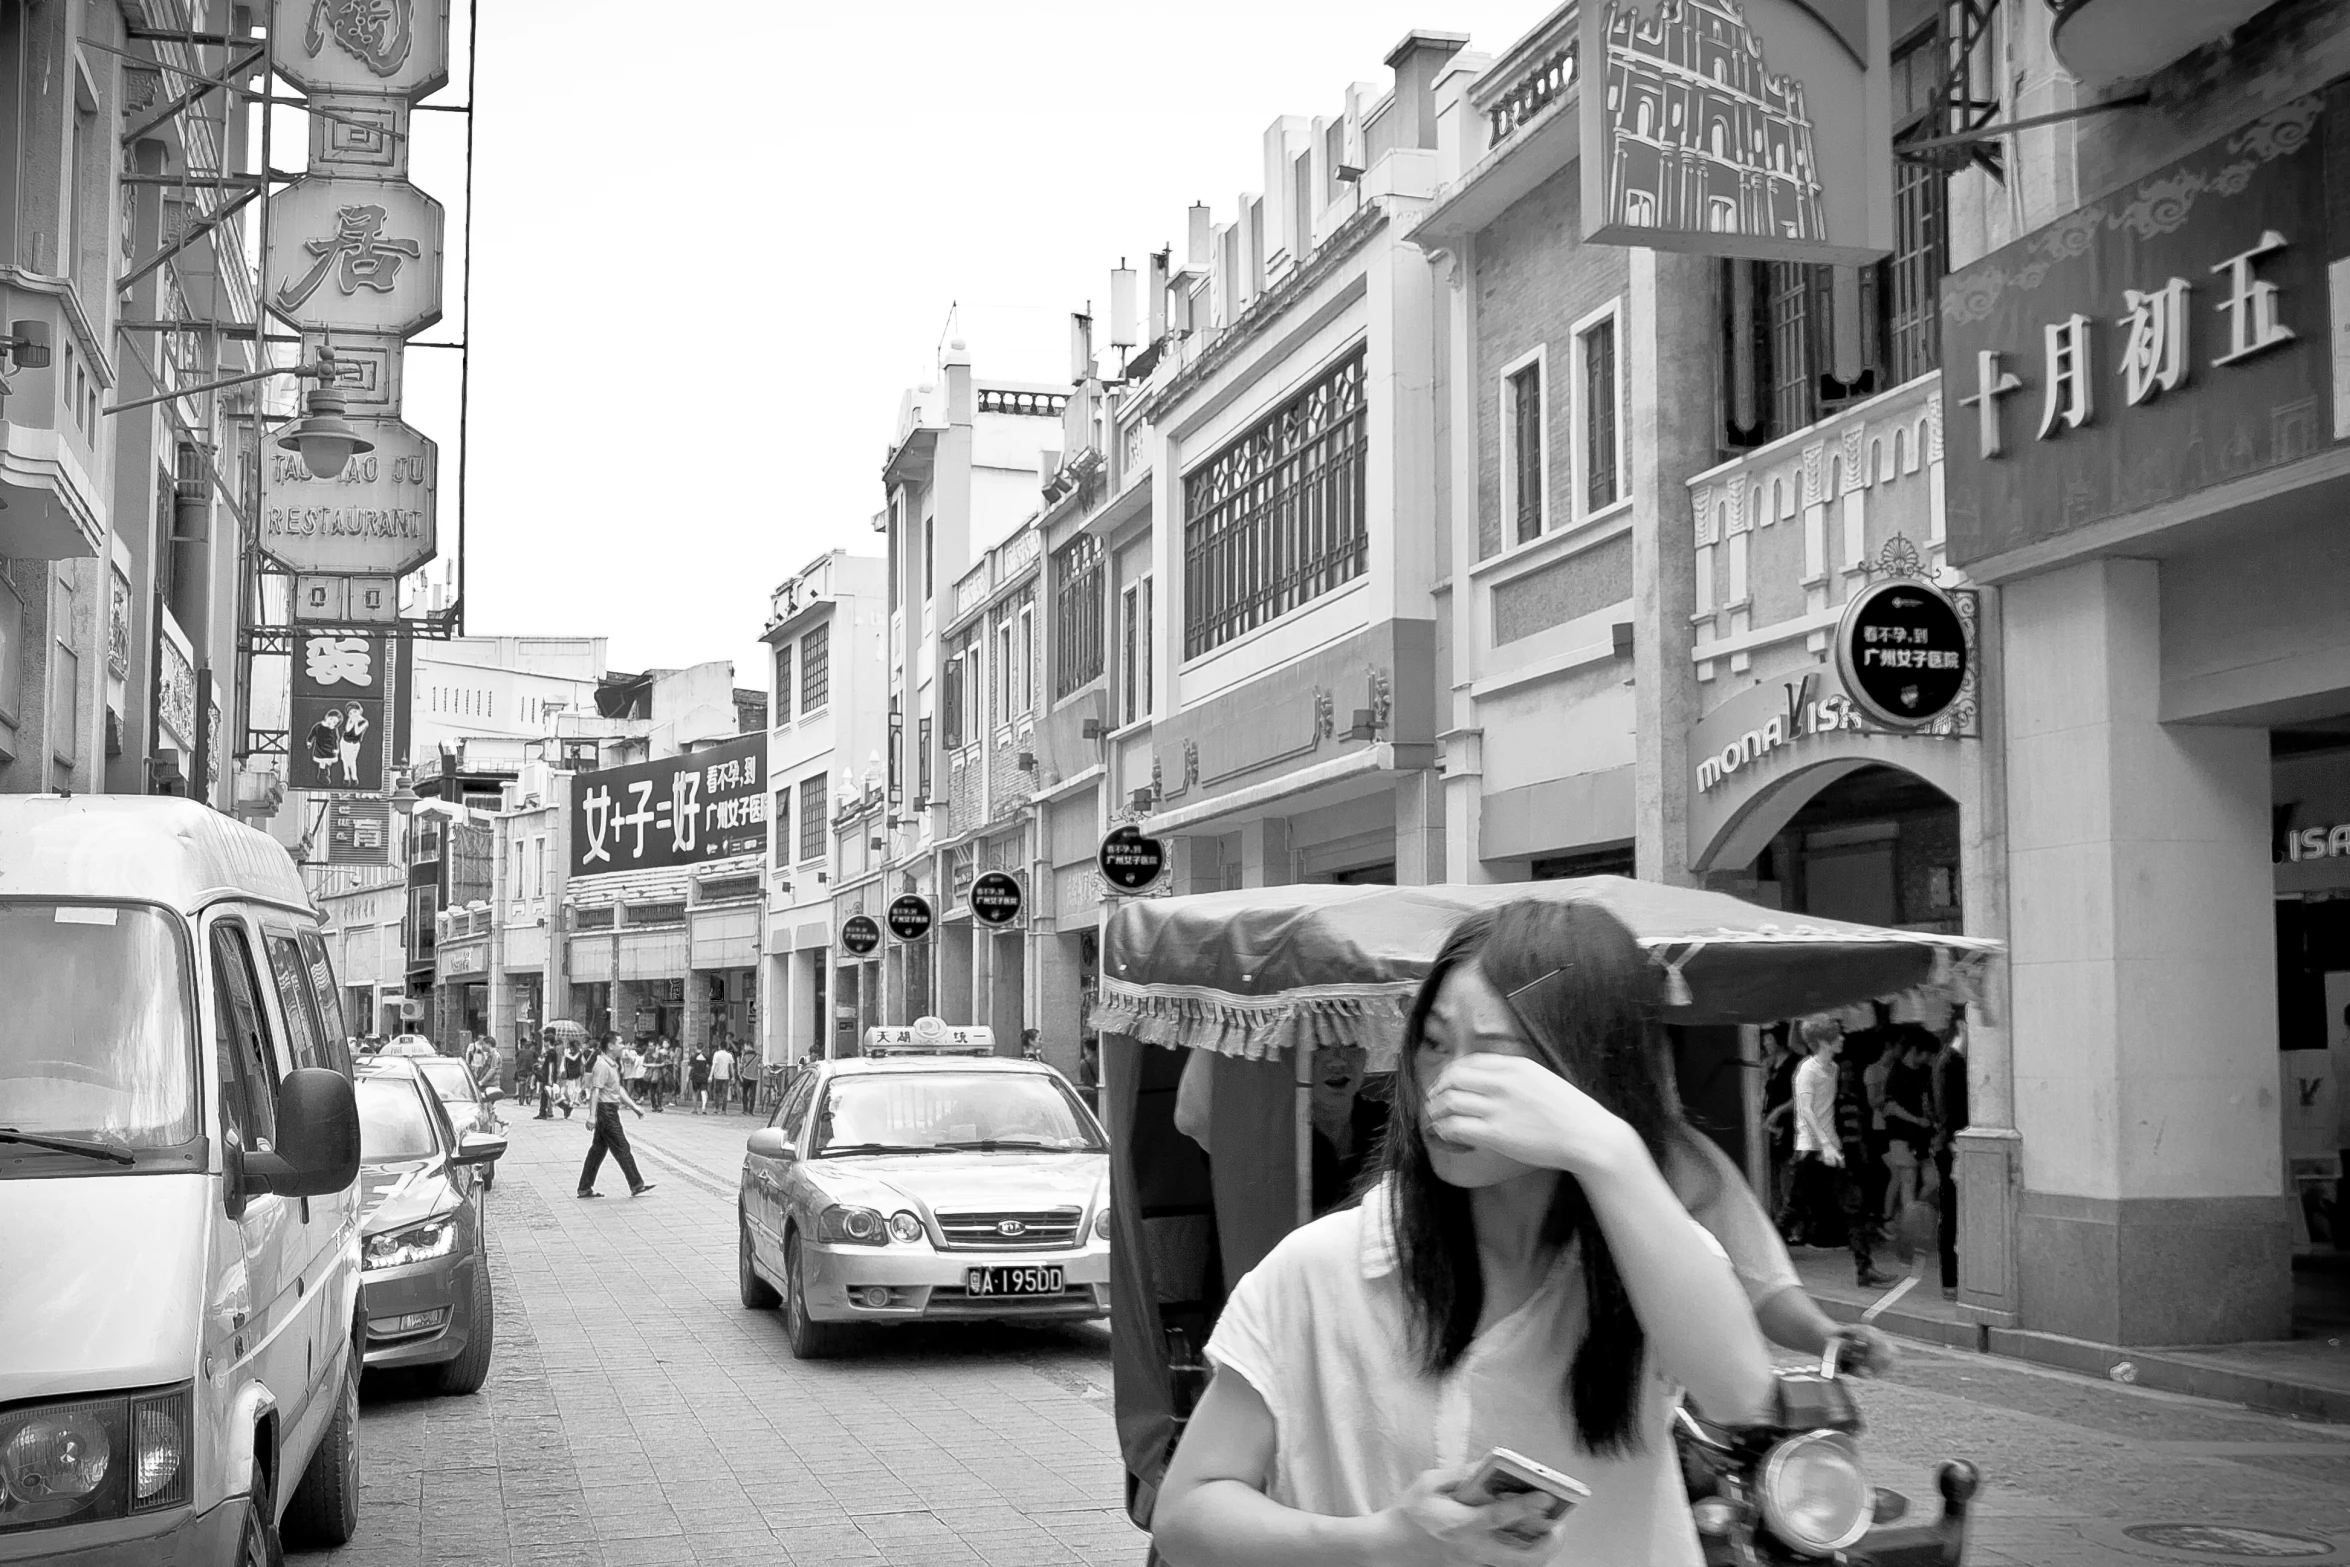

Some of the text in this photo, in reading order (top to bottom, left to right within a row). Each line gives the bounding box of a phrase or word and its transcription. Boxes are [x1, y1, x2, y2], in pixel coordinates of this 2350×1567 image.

[1958, 229, 2296, 461] 十月初五
[338, 455, 380, 484] AO
[392, 455, 425, 485] JU
[268, 504, 424, 538] RESTAURANT
[1863, 648, 1960, 669] 广州女子医院
